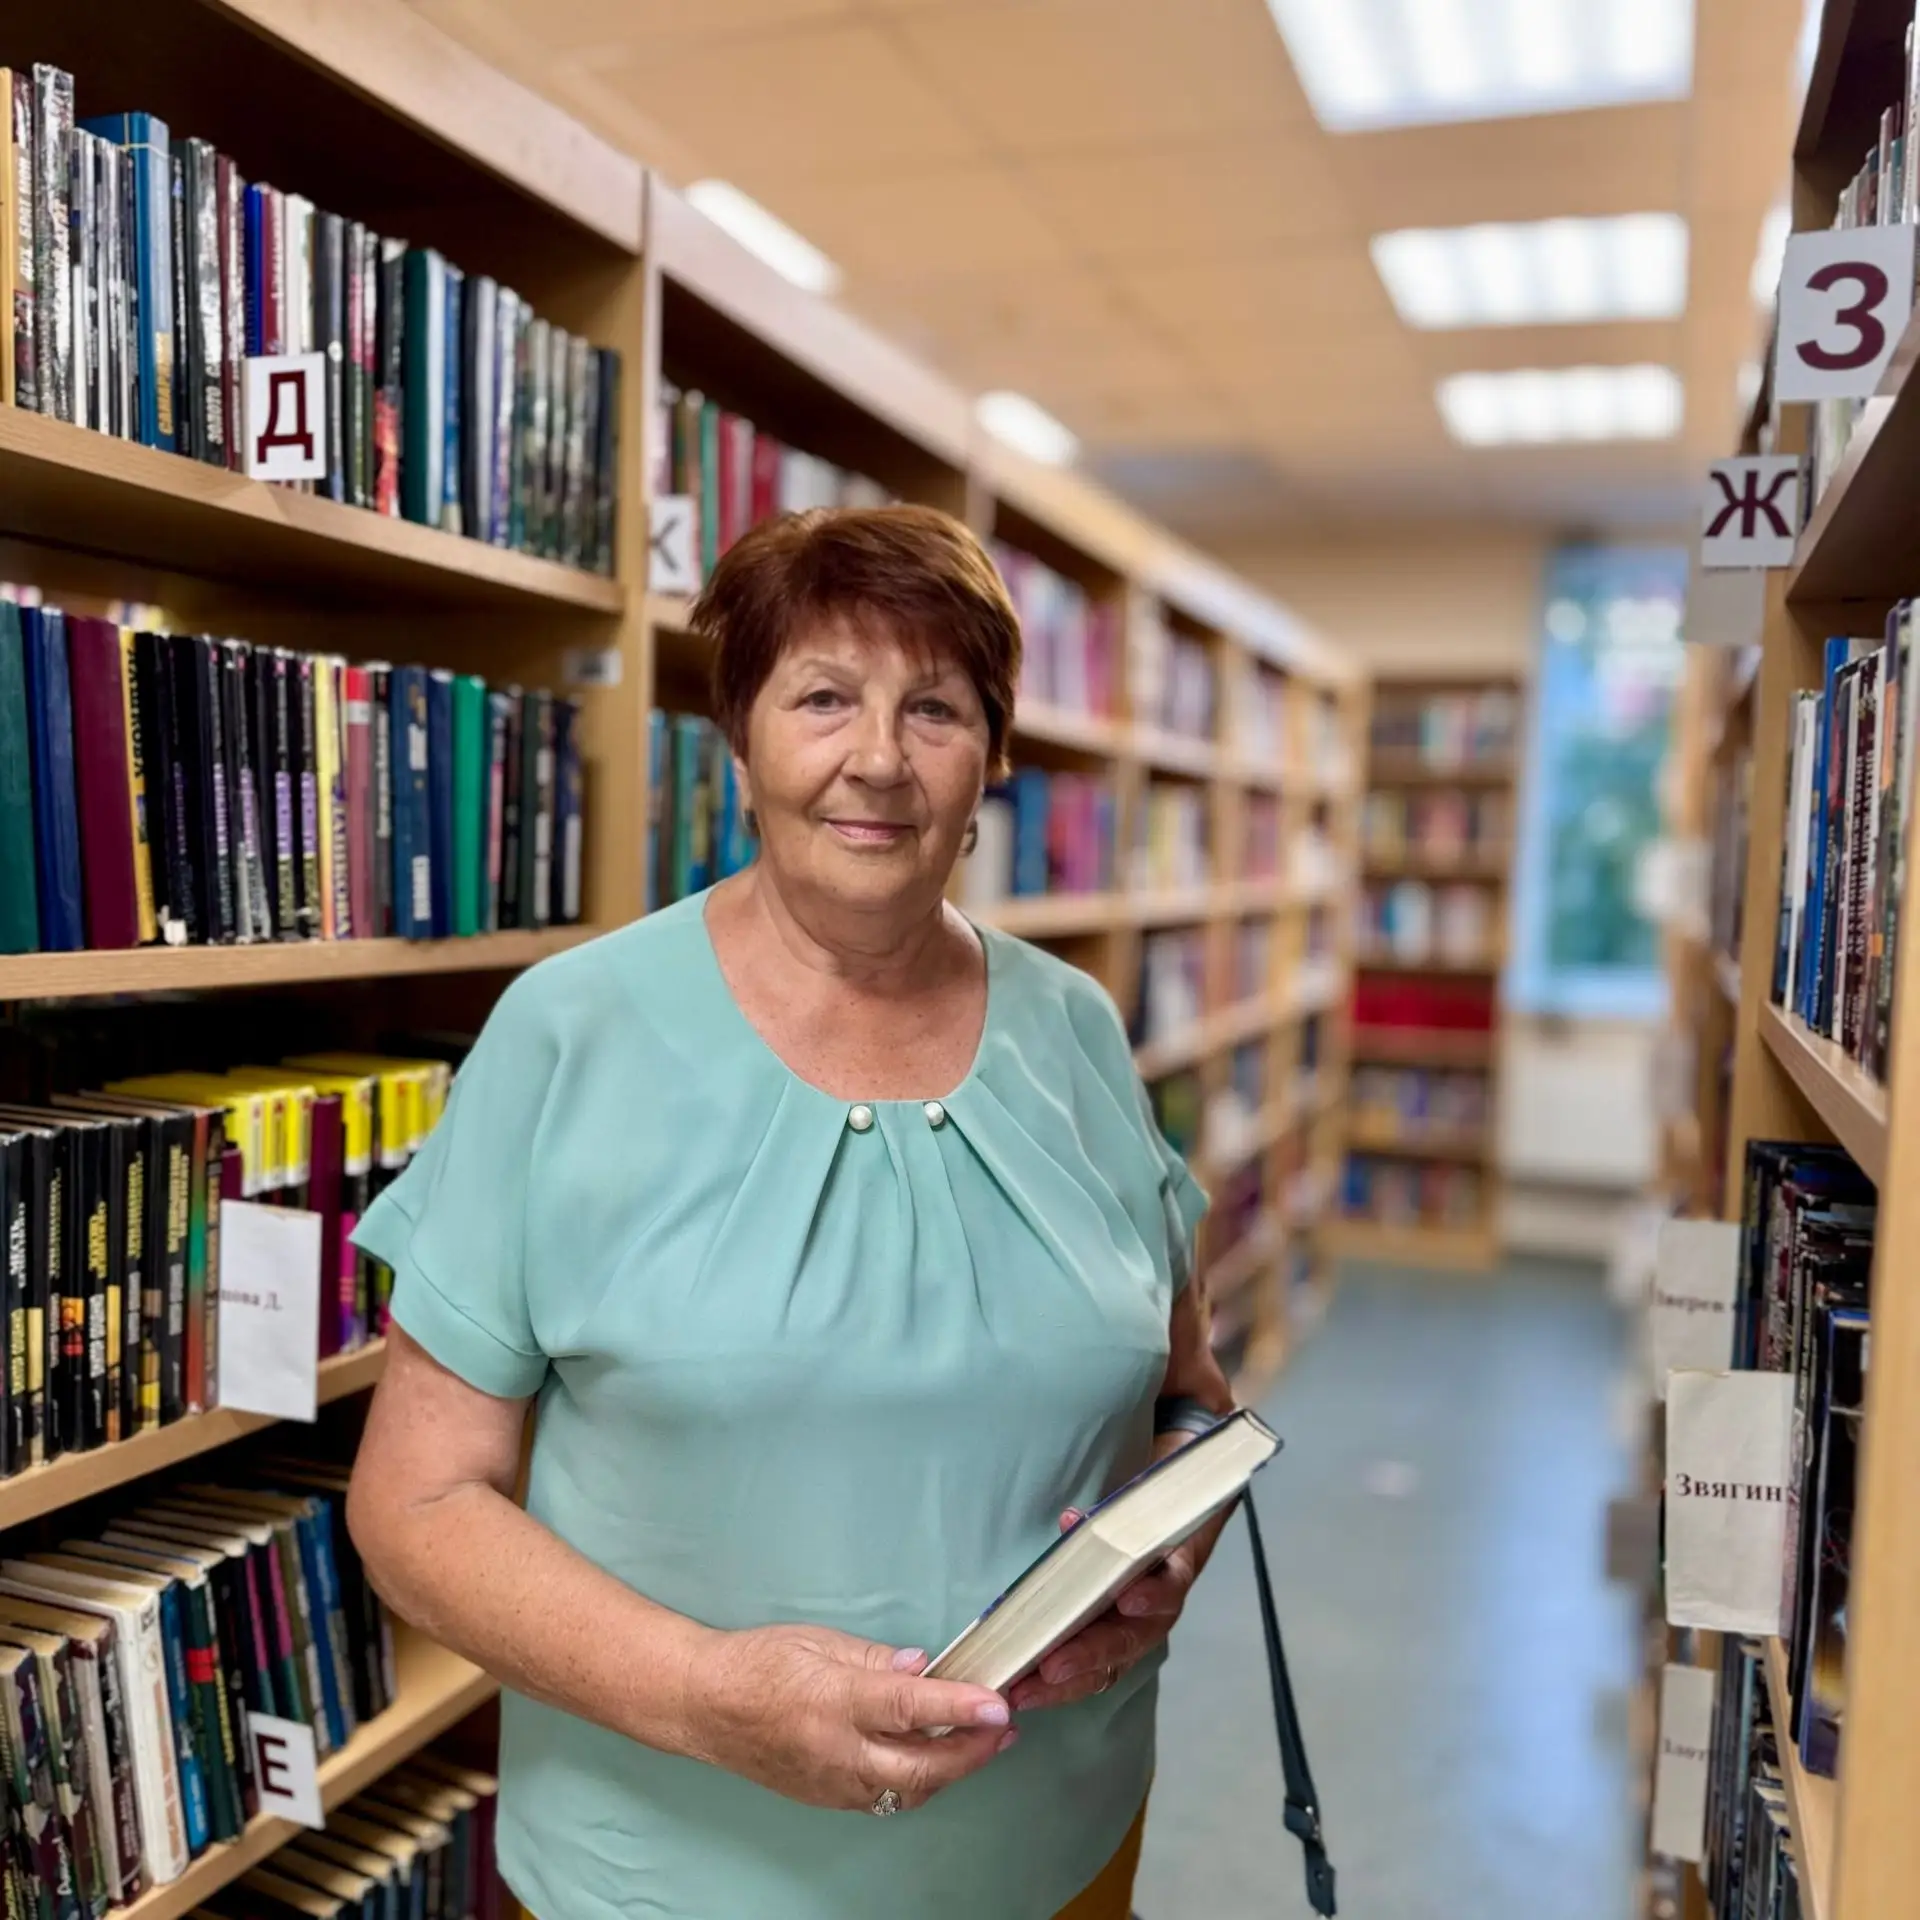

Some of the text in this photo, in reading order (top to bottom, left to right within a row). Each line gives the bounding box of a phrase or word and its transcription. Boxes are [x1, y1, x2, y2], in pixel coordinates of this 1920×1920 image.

[257, 369, 314, 465] Д
[1704, 470, 1797, 538] Ж
[256, 1735, 294, 1798] Е
